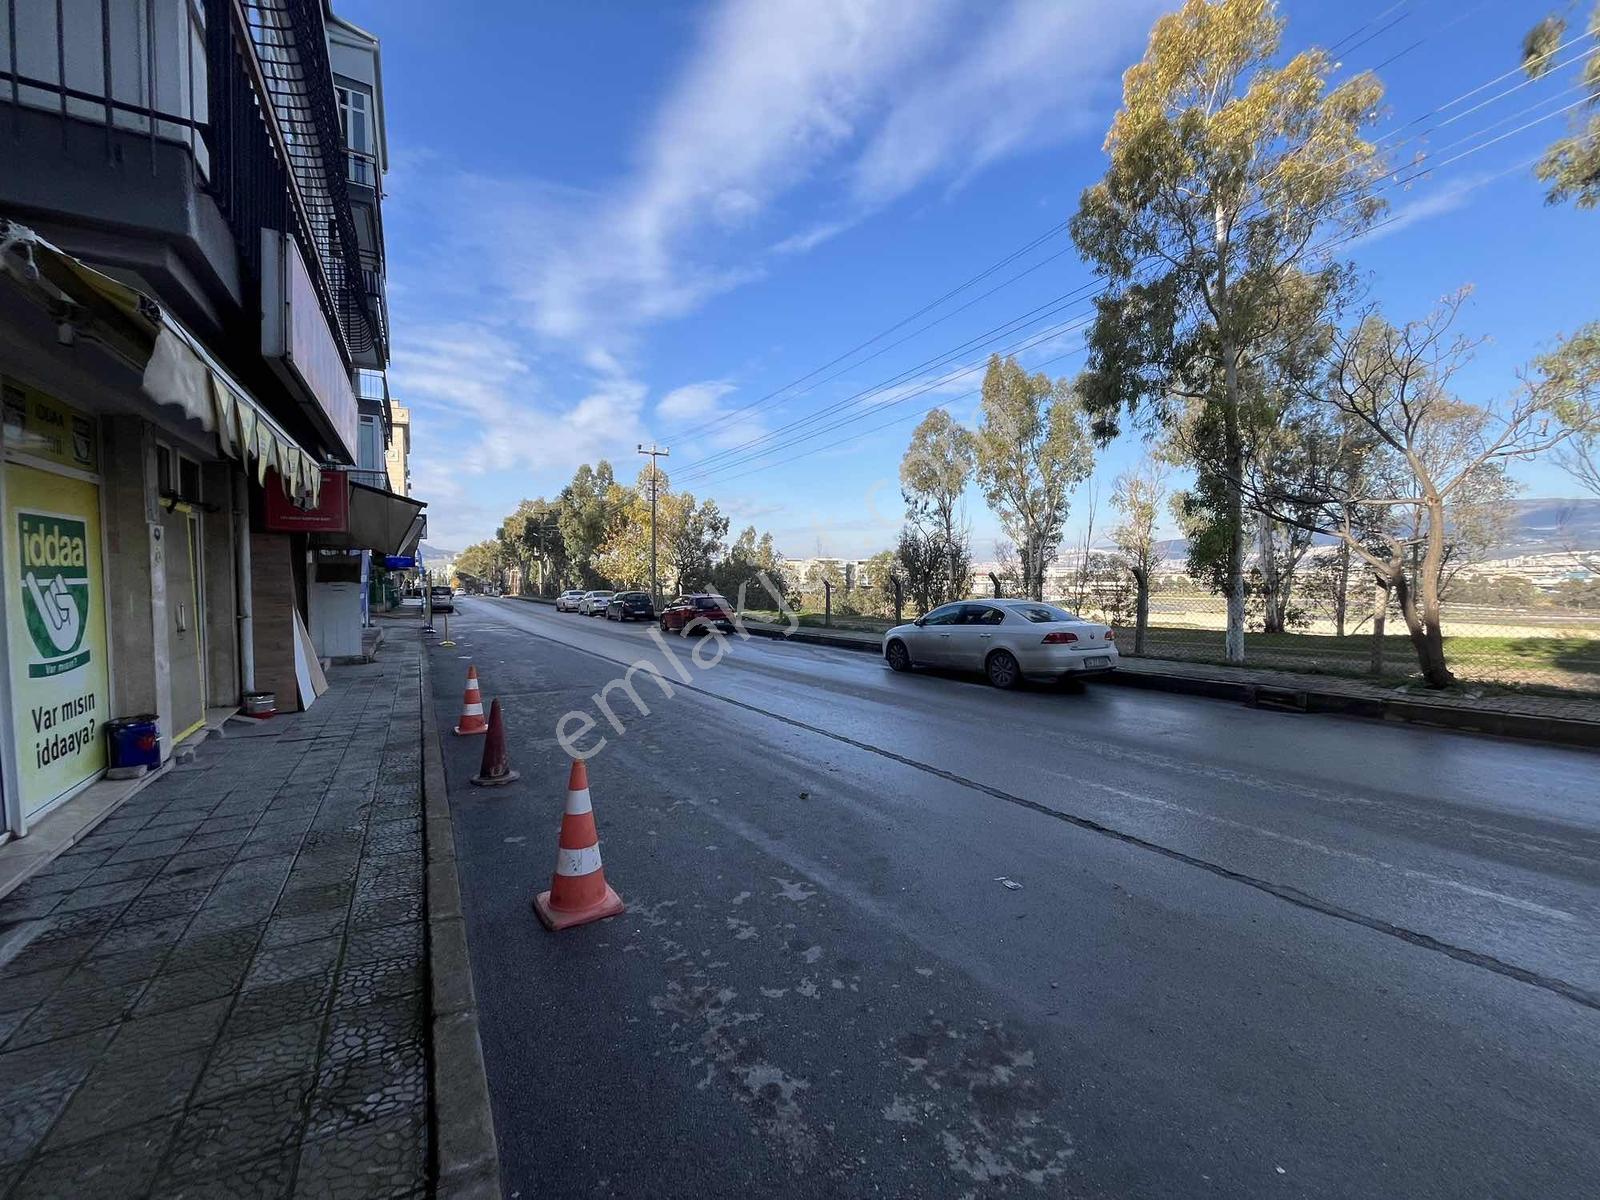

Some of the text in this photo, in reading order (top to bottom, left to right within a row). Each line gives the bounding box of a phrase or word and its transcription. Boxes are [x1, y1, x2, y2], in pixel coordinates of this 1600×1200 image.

[23, 520, 84, 567] iddaa
[31, 706, 58, 733] Var
[36, 718, 95, 769] iddaaya?
